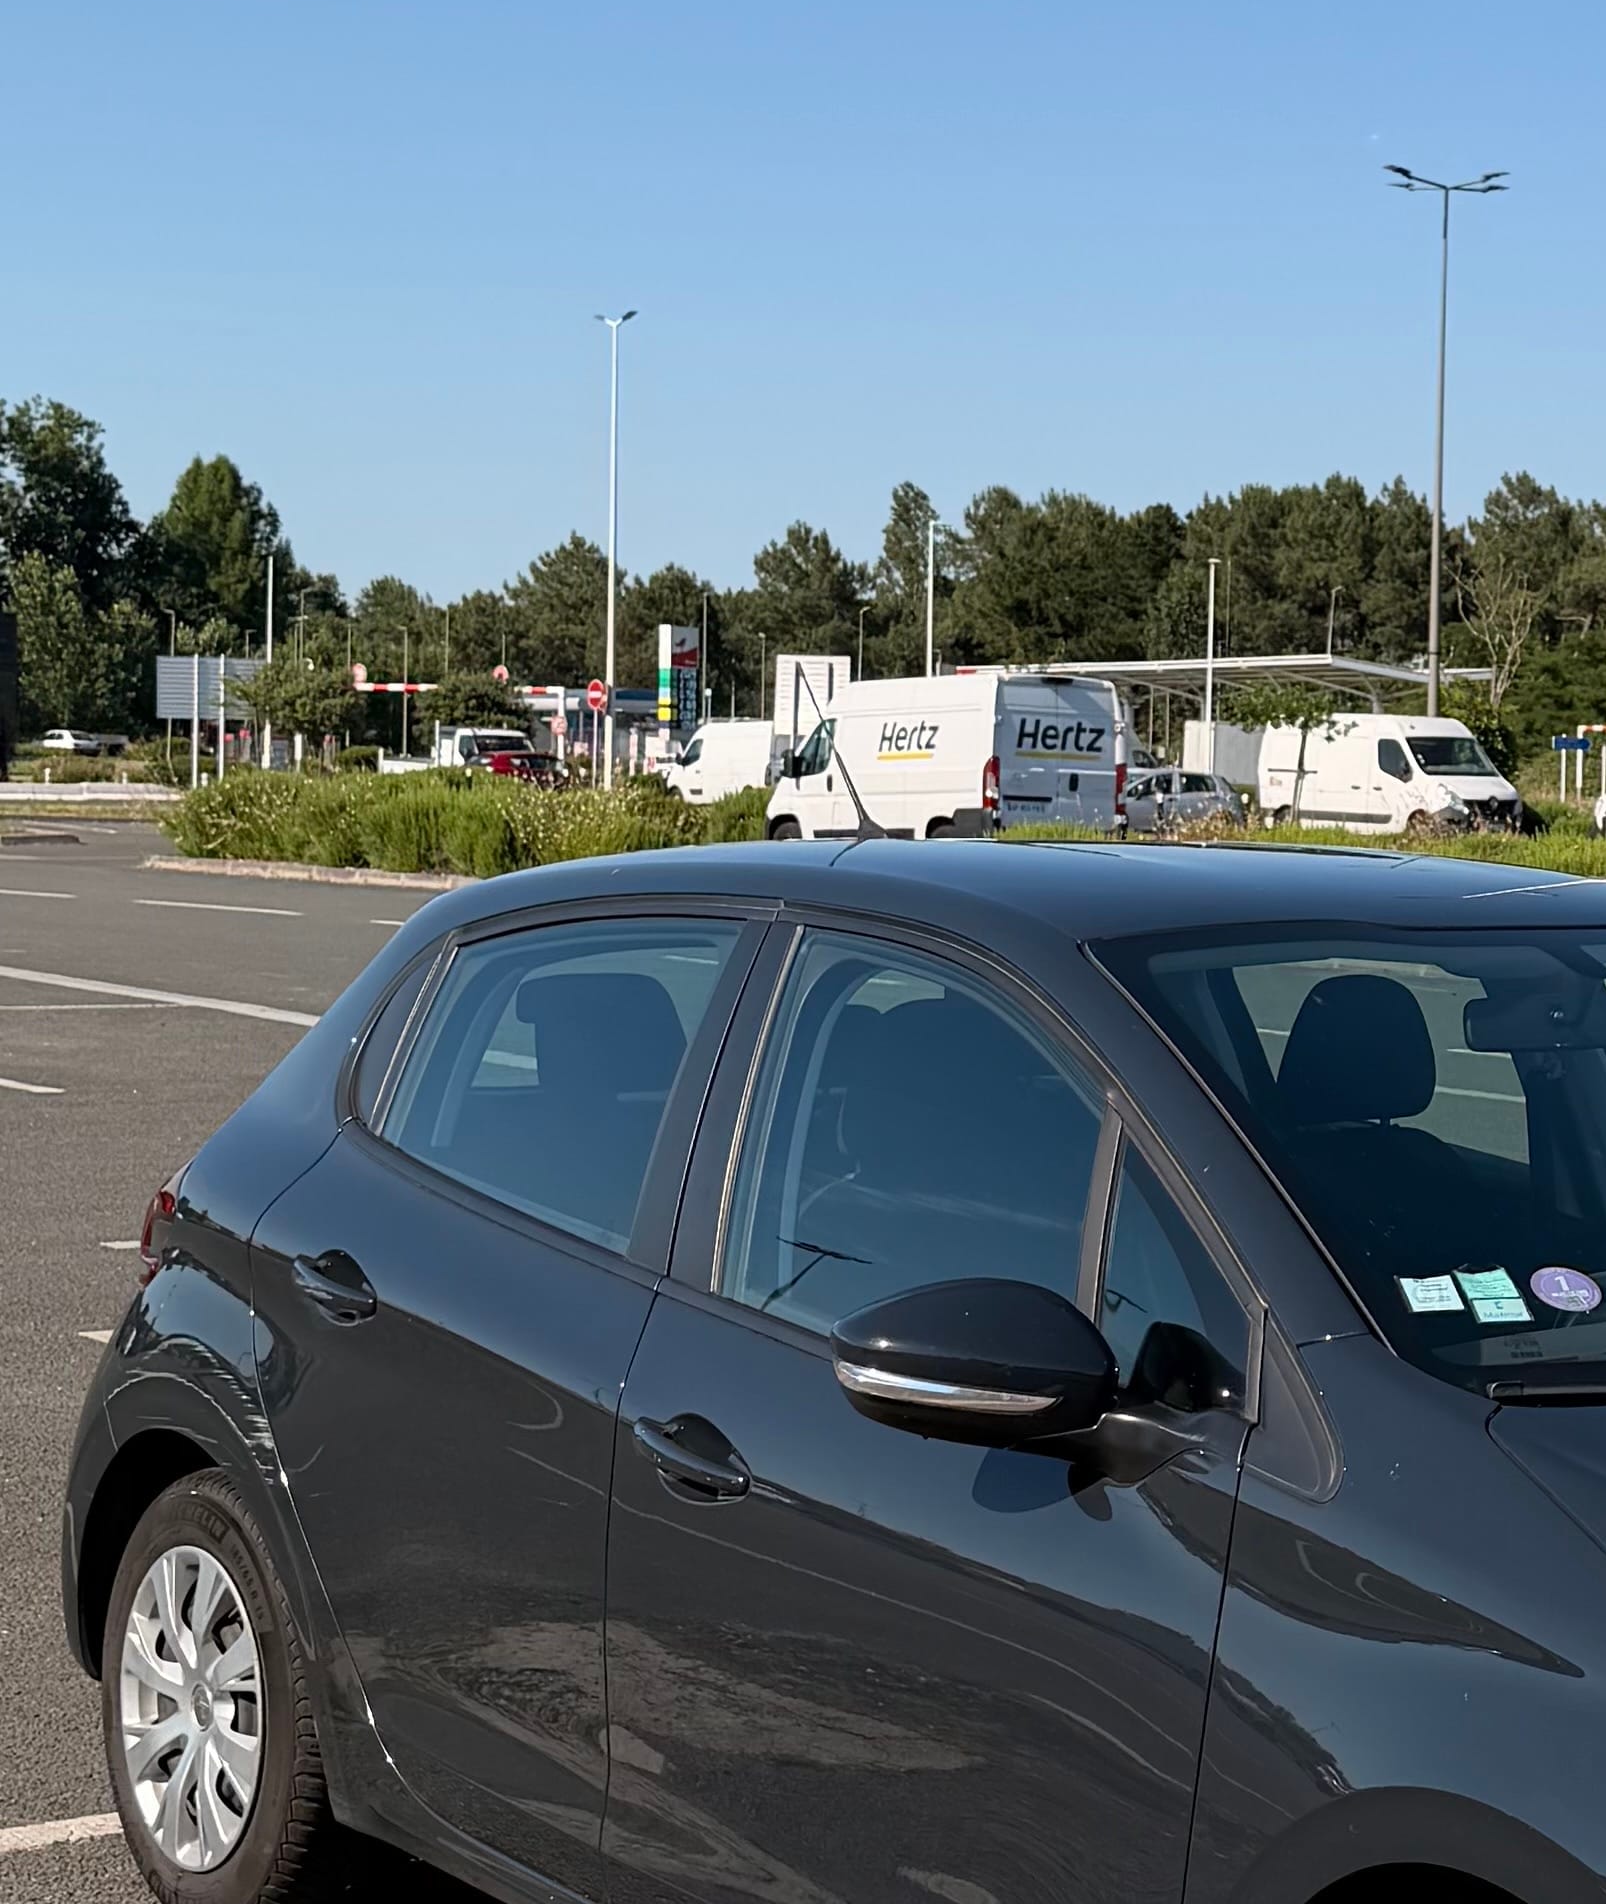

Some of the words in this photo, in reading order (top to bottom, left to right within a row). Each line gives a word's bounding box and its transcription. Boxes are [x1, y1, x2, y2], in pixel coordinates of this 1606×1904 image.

[878, 720, 939, 752] Hertz
[1015, 718, 1105, 753] Hertz
[1554, 1275, 1569, 1291] 1
